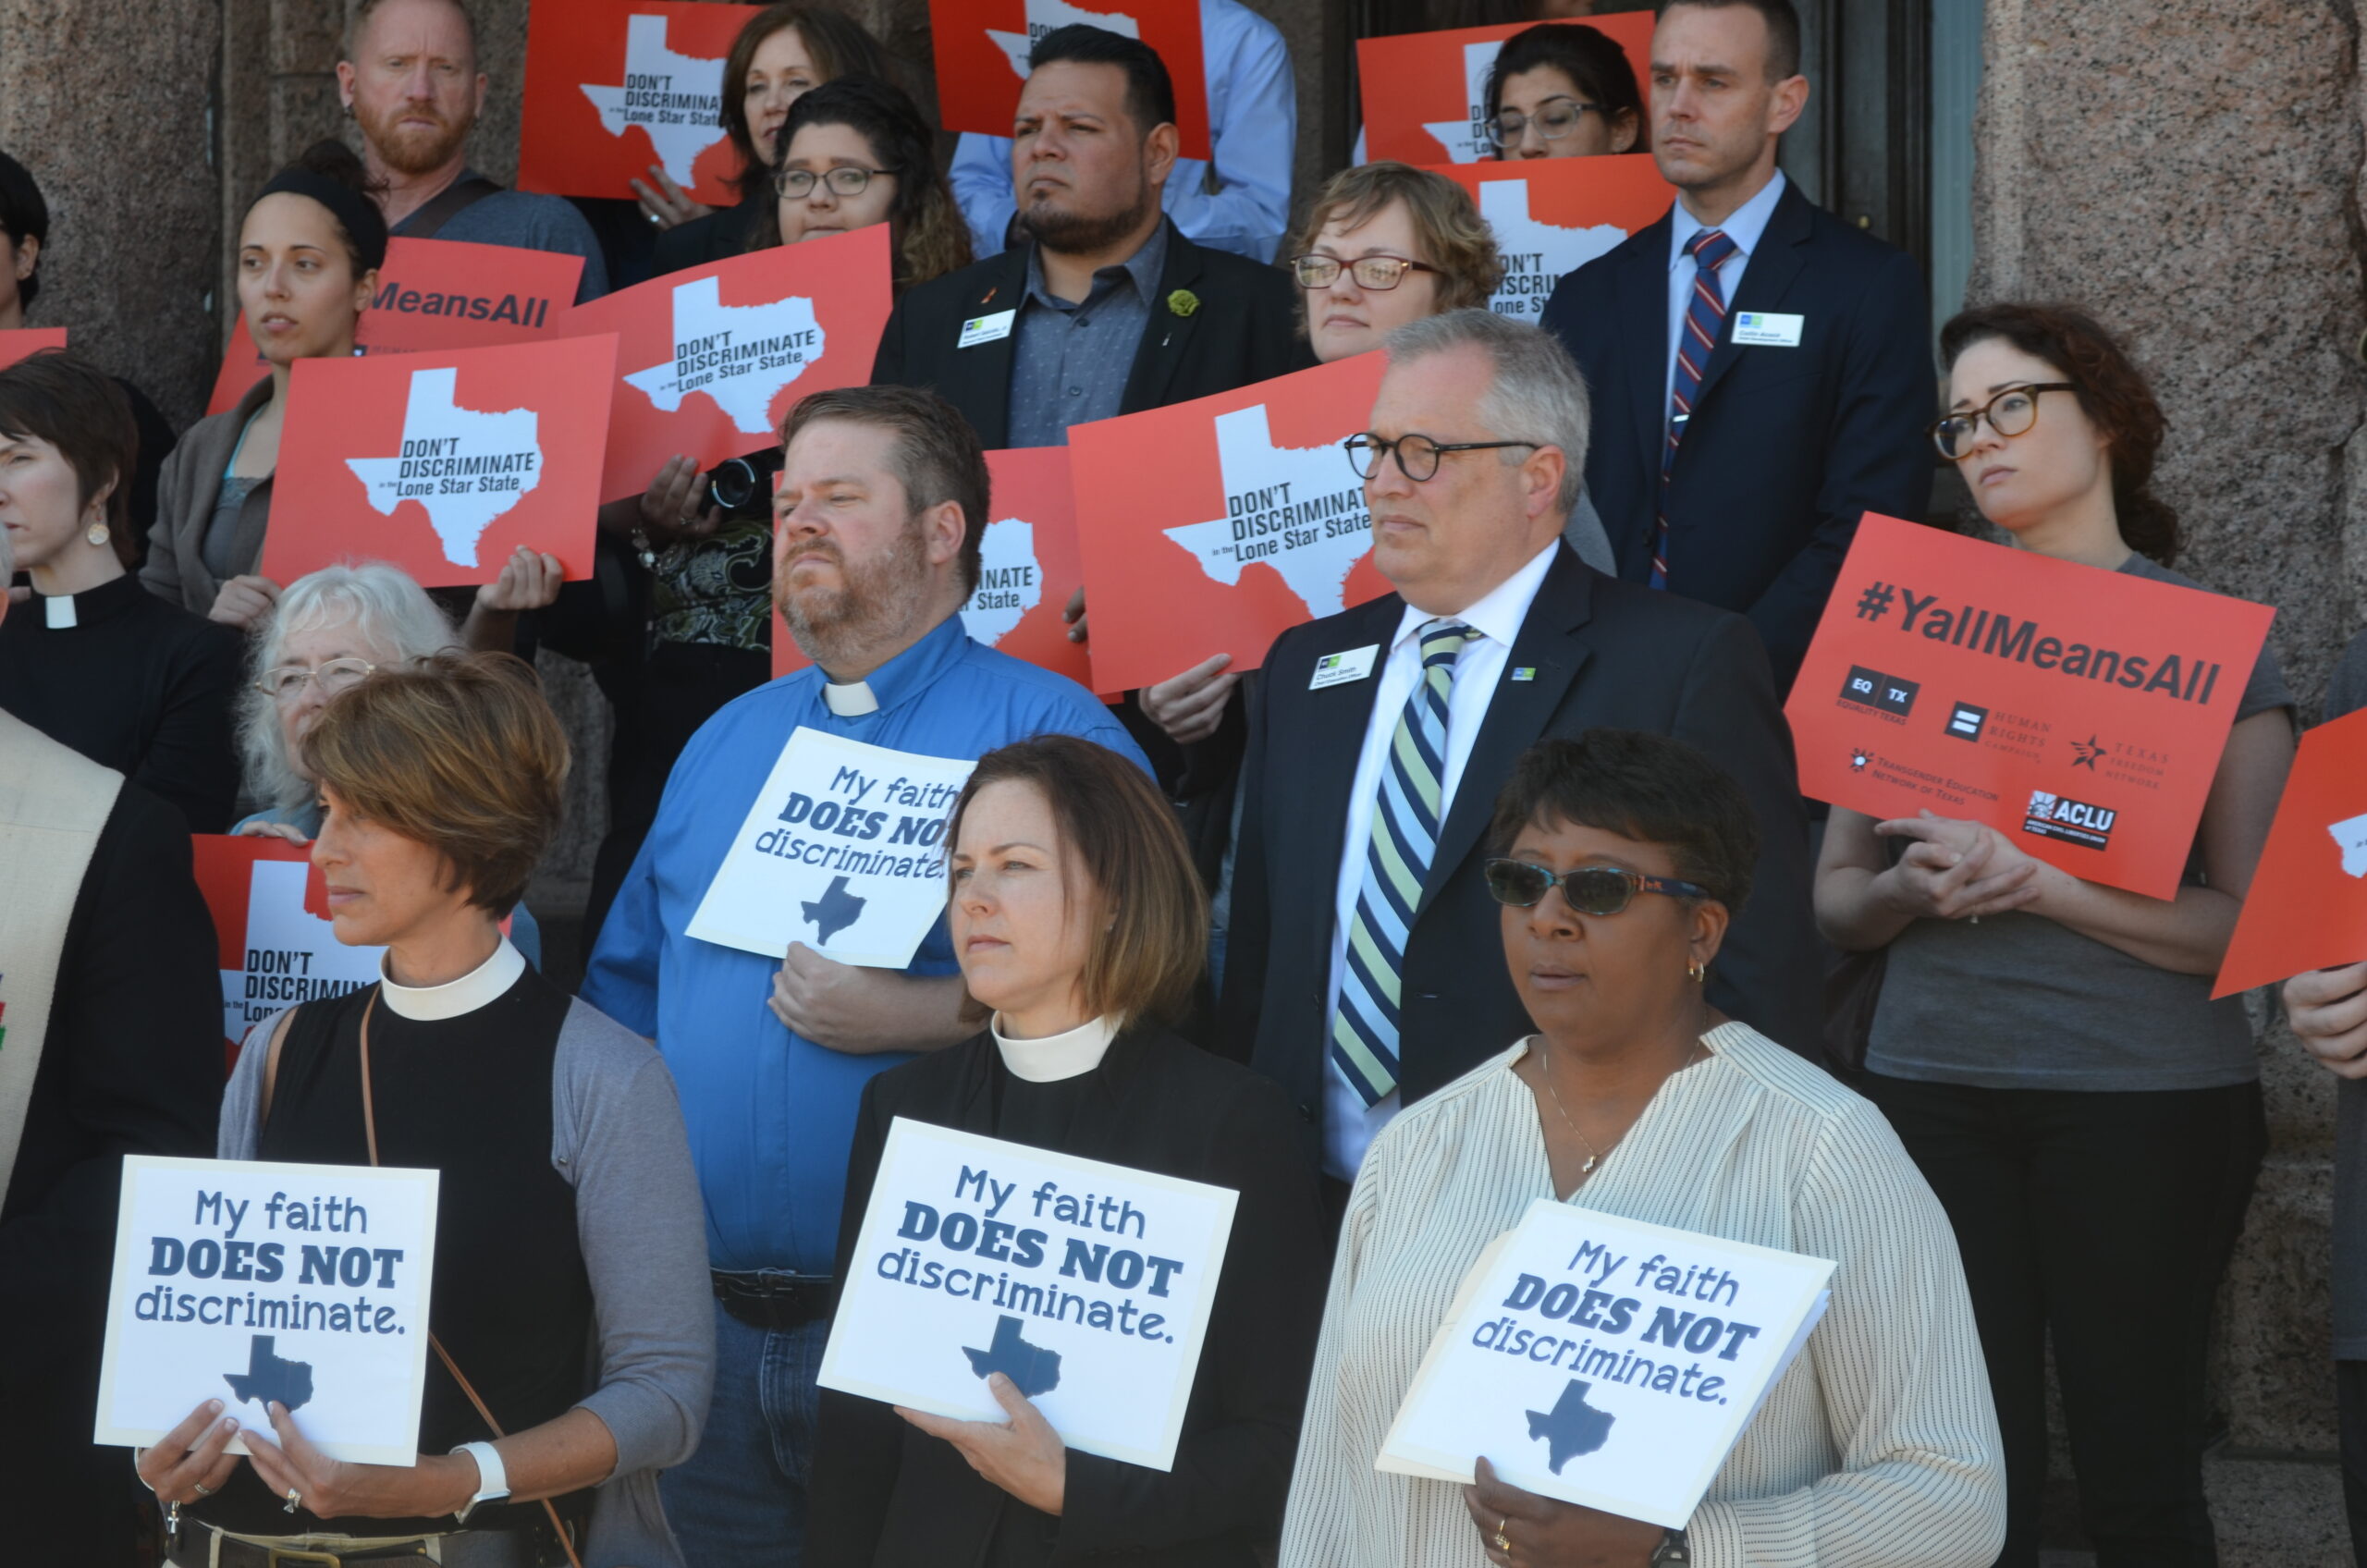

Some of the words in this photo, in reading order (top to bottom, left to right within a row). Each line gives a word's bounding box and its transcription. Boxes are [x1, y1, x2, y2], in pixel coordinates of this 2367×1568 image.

[627, 74, 673, 91] DON'T
[623, 108, 654, 123] Lone
[658, 110, 685, 125] Star
[690, 112, 720, 126] Stat
[625, 92, 721, 111] DISCRIMINA
[1498, 253, 1543, 274] ON'T
[372, 282, 549, 328] MeansAll
[1495, 301, 1525, 314] one
[677, 330, 732, 361] DON'T
[677, 329, 816, 377] DISCRIMINATE
[678, 372, 714, 393] Lone
[719, 362, 754, 379] Star
[759, 351, 803, 371] State
[399, 452, 534, 479] DISCRIMINATE
[402, 437, 460, 459] DON'T
[397, 481, 434, 496] Lone
[439, 478, 473, 495] Star
[478, 475, 520, 493] State
[1229, 482, 1292, 518] DON'T
[1232, 486, 1368, 542] DISCRIMINAT
[1235, 539, 1279, 562] Lone
[1284, 527, 1319, 551] Star
[1325, 512, 1372, 539] State
[977, 591, 1020, 610] State
[1857, 581, 2221, 705] #YallMeansAll
[1851, 678, 1872, 693] EQ
[1888, 688, 1908, 703] TX
[1835, 699, 1878, 717] EQUALITY
[1879, 713, 1907, 726] TEXAS
[1994, 711, 2051, 732] HUMAN
[1989, 726, 2046, 747] RIGHTS
[2115, 741, 2169, 764] TEXAS
[829, 766, 878, 805] My
[884, 777, 960, 809] faith
[778, 791, 889, 840] DOES
[888, 815, 947, 847] NO
[2054, 800, 2115, 831] ACLU
[754, 827, 945, 879] discriminate.
[247, 949, 313, 975] DON'T
[245, 975, 365, 1001] DISCRIMI
[194, 1190, 250, 1239] My
[264, 1191, 367, 1233] faith
[954, 1165, 1016, 1219] My
[1033, 1182, 1146, 1240] faith
[148, 1236, 285, 1282] DOES
[298, 1244, 404, 1289] NOT
[897, 1200, 1049, 1268] DOES
[1059, 1237, 1184, 1298] NOT
[1567, 1240, 1629, 1288] My
[1635, 1254, 1740, 1307] faith
[135, 1285, 405, 1335] discriminate.
[877, 1247, 1173, 1344] discriminate.
[1502, 1272, 1641, 1335] DOES
[1640, 1305, 1761, 1362] NOT
[1472, 1317, 1727, 1405] discriminate.
